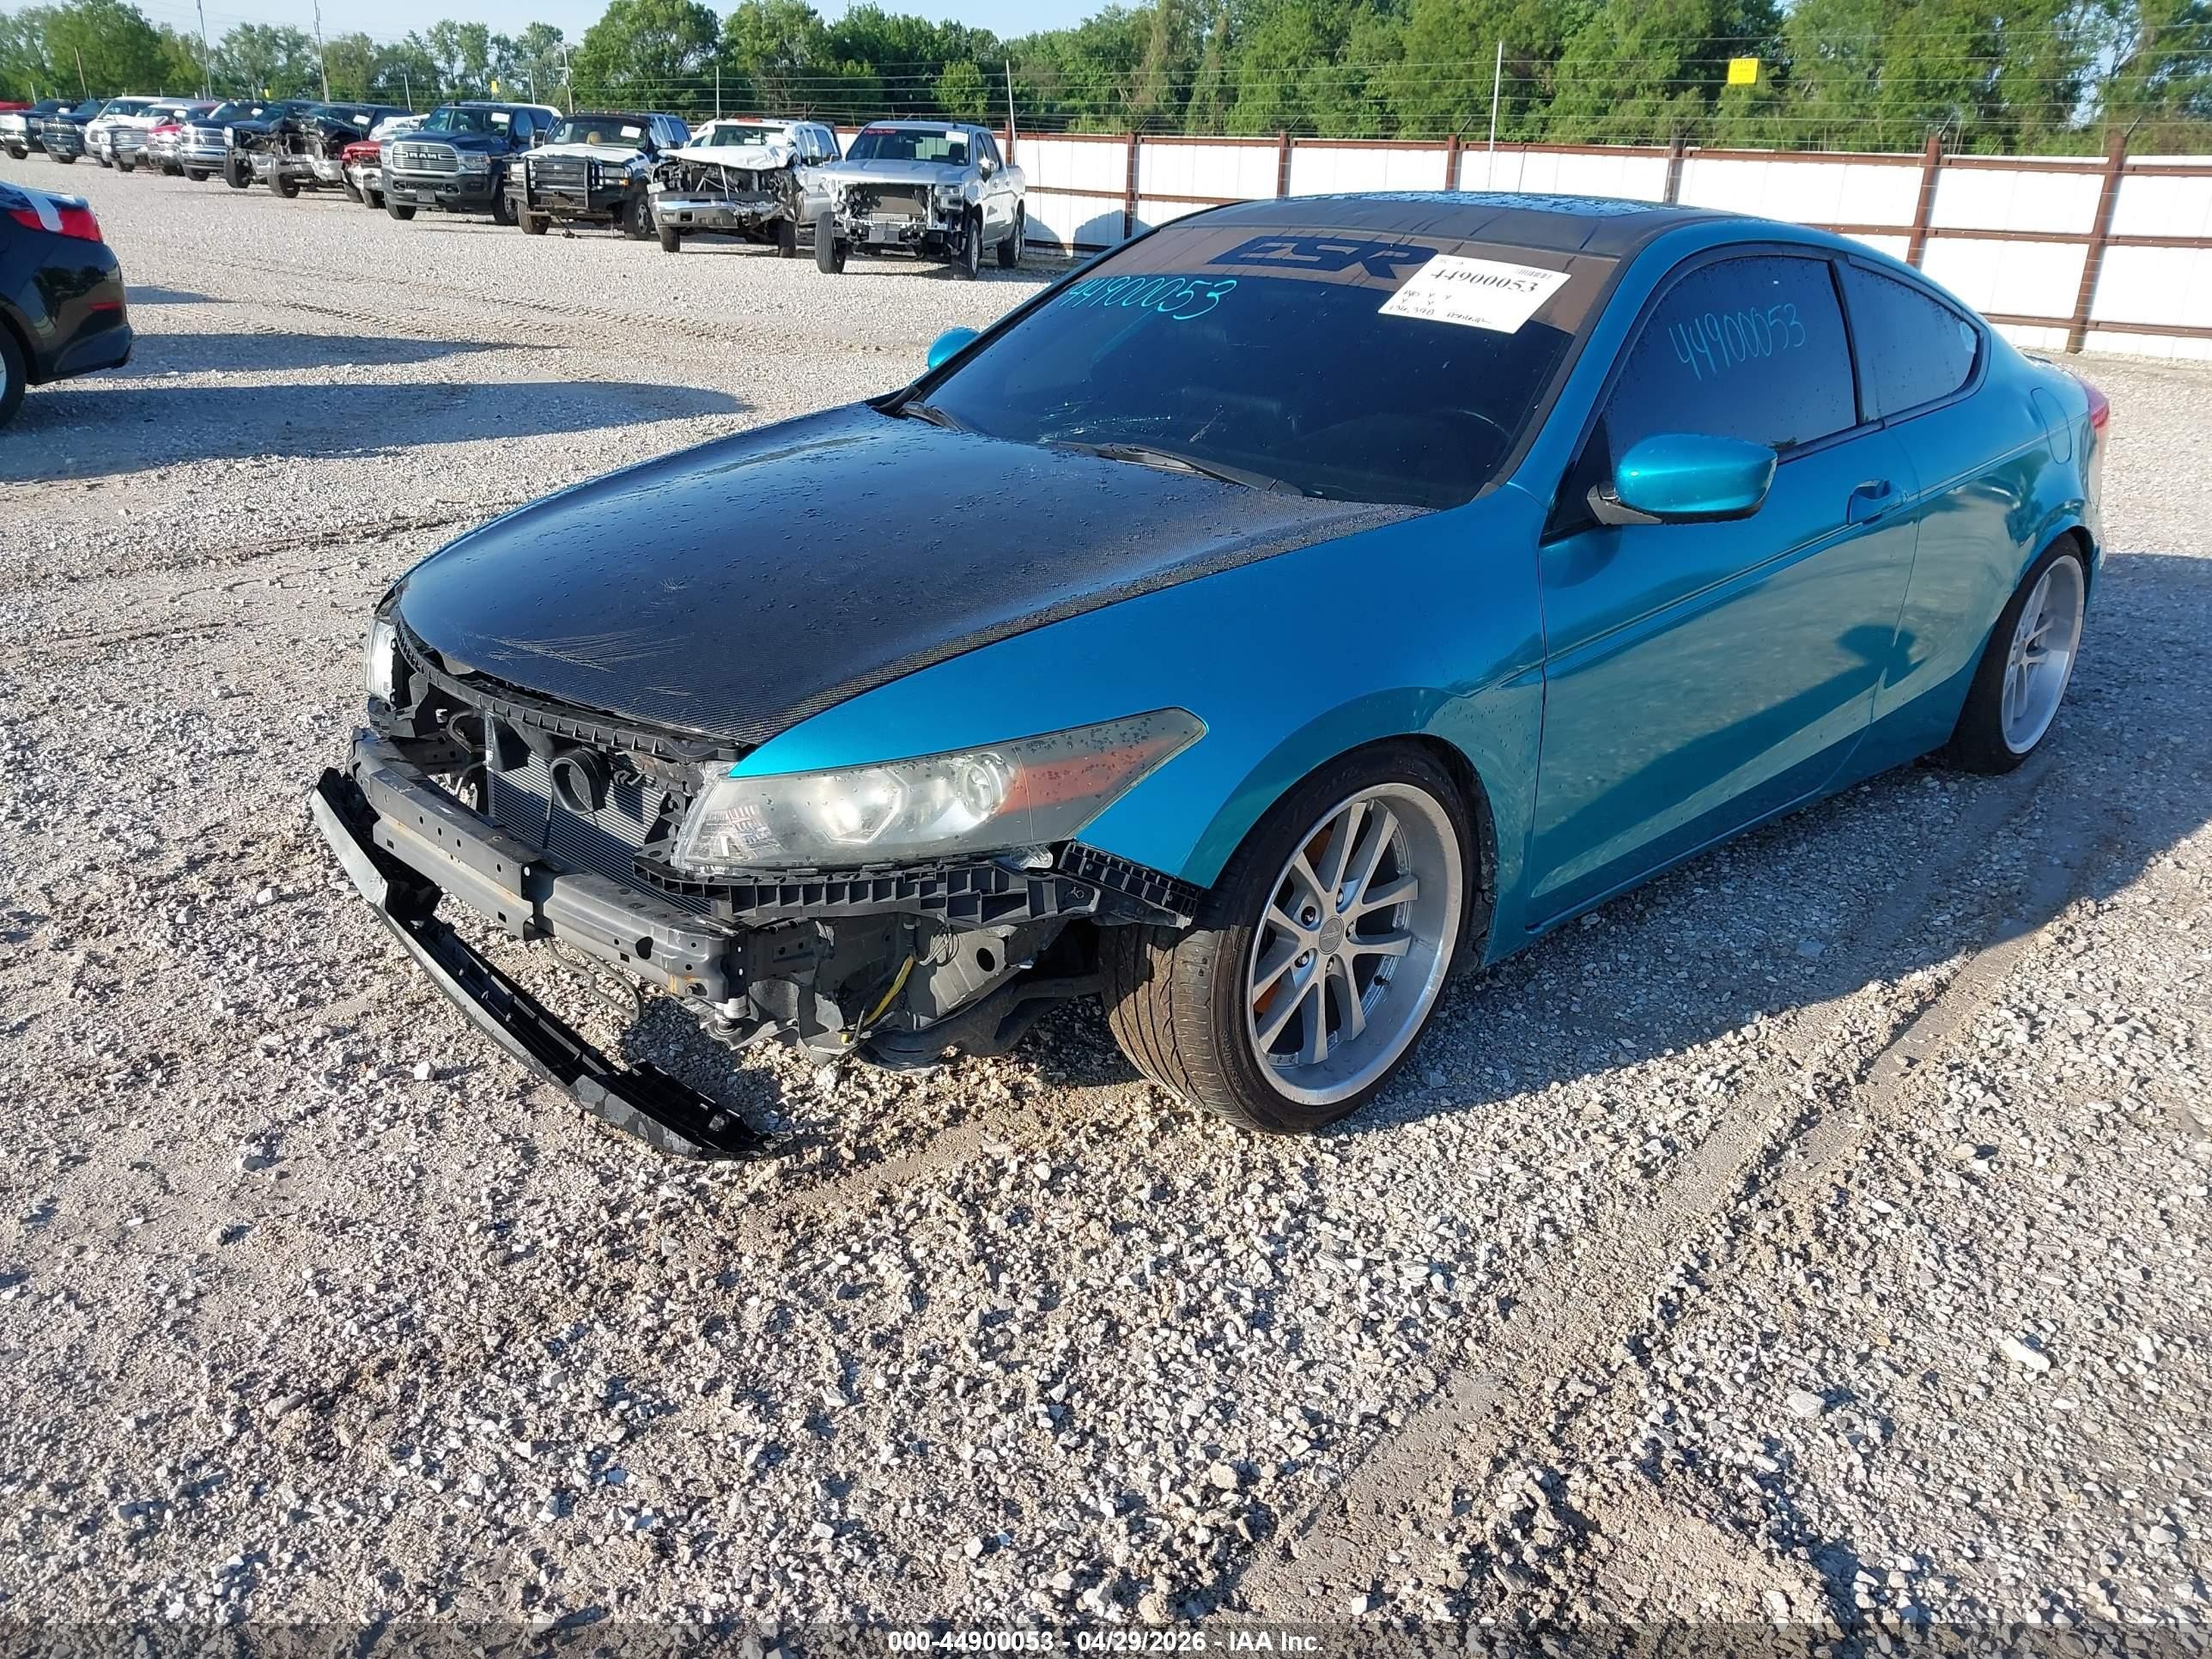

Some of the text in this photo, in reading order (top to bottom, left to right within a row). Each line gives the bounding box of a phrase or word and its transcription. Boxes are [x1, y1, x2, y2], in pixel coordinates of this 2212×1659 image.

[1206, 235, 1438, 279] ESR
[1059, 276, 1237, 320] 44900053
[1431, 268, 1539, 294] 44900053
[1668, 303, 1807, 381] 44900053
